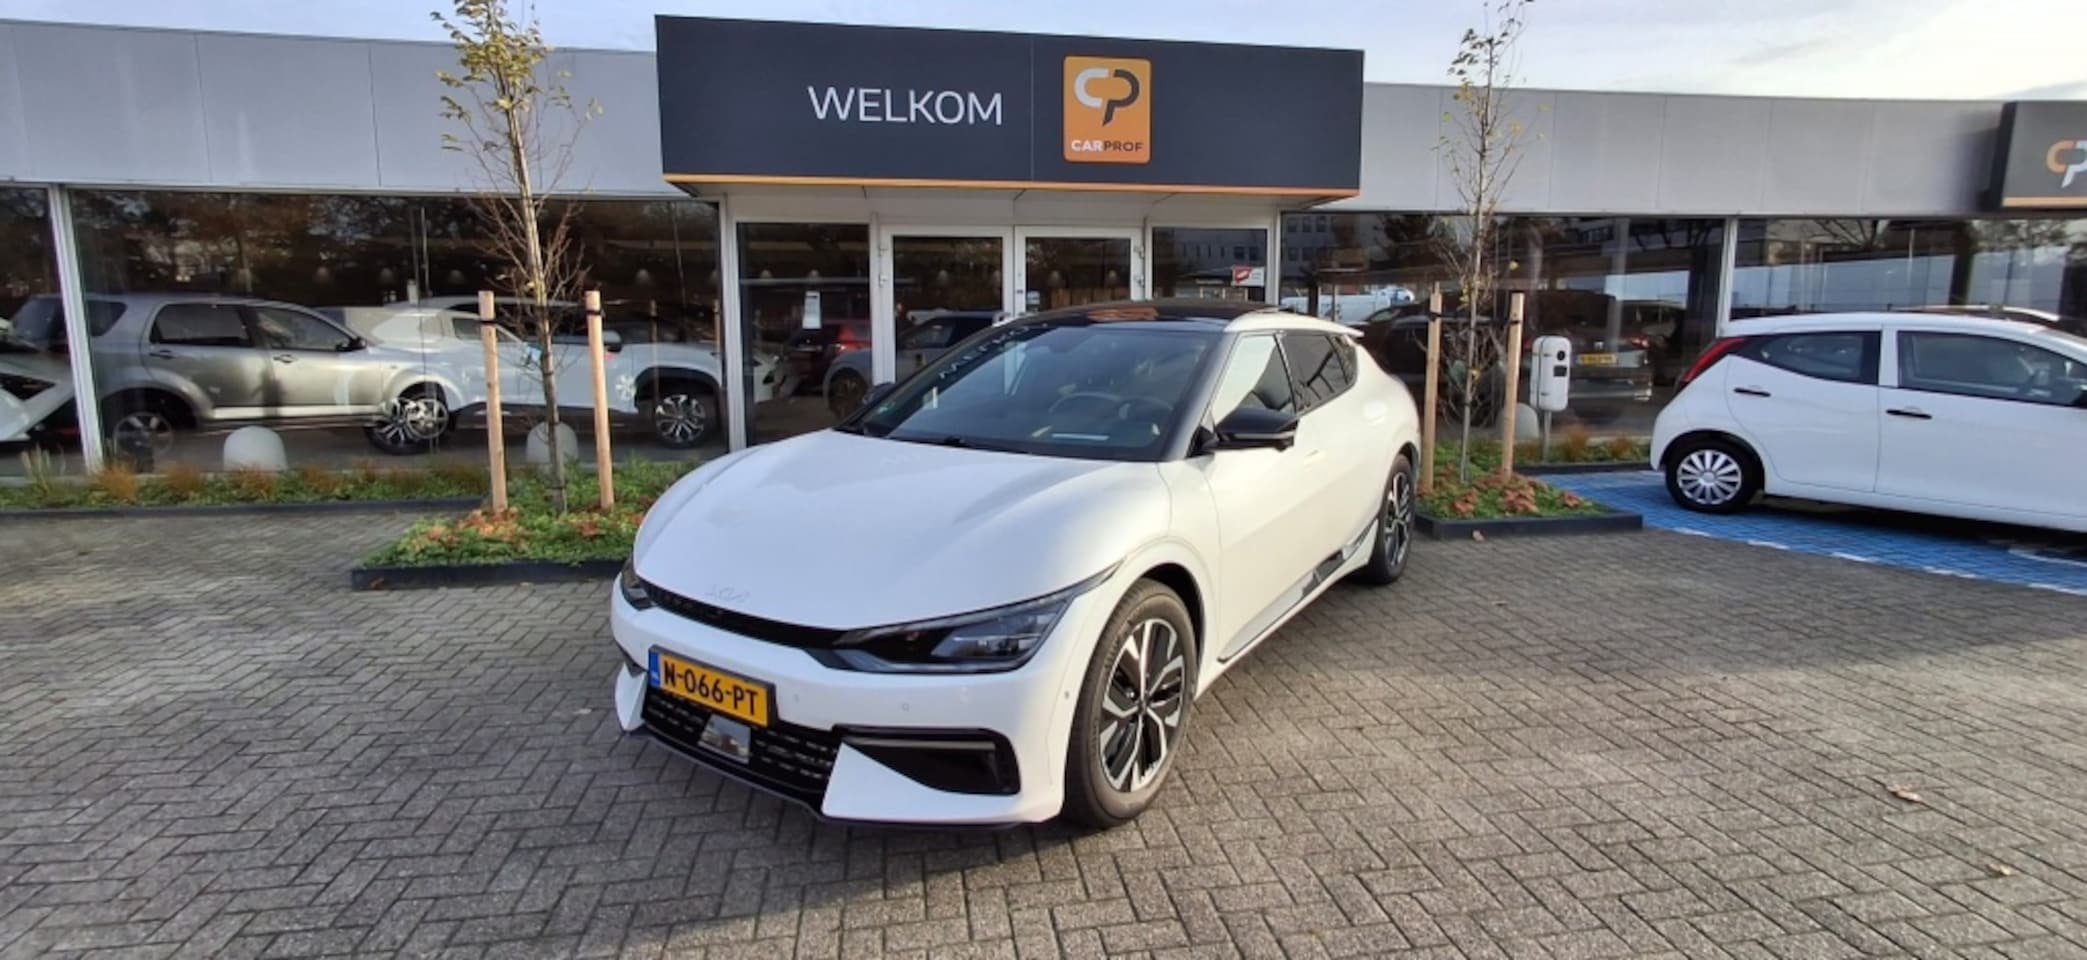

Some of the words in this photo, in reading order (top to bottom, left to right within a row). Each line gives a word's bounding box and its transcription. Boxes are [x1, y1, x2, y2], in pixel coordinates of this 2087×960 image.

[808, 86, 1002, 125] WELKOM
[1071, 139, 1144, 152] CARPROF
[663, 660, 758, 716] N-066-PT
